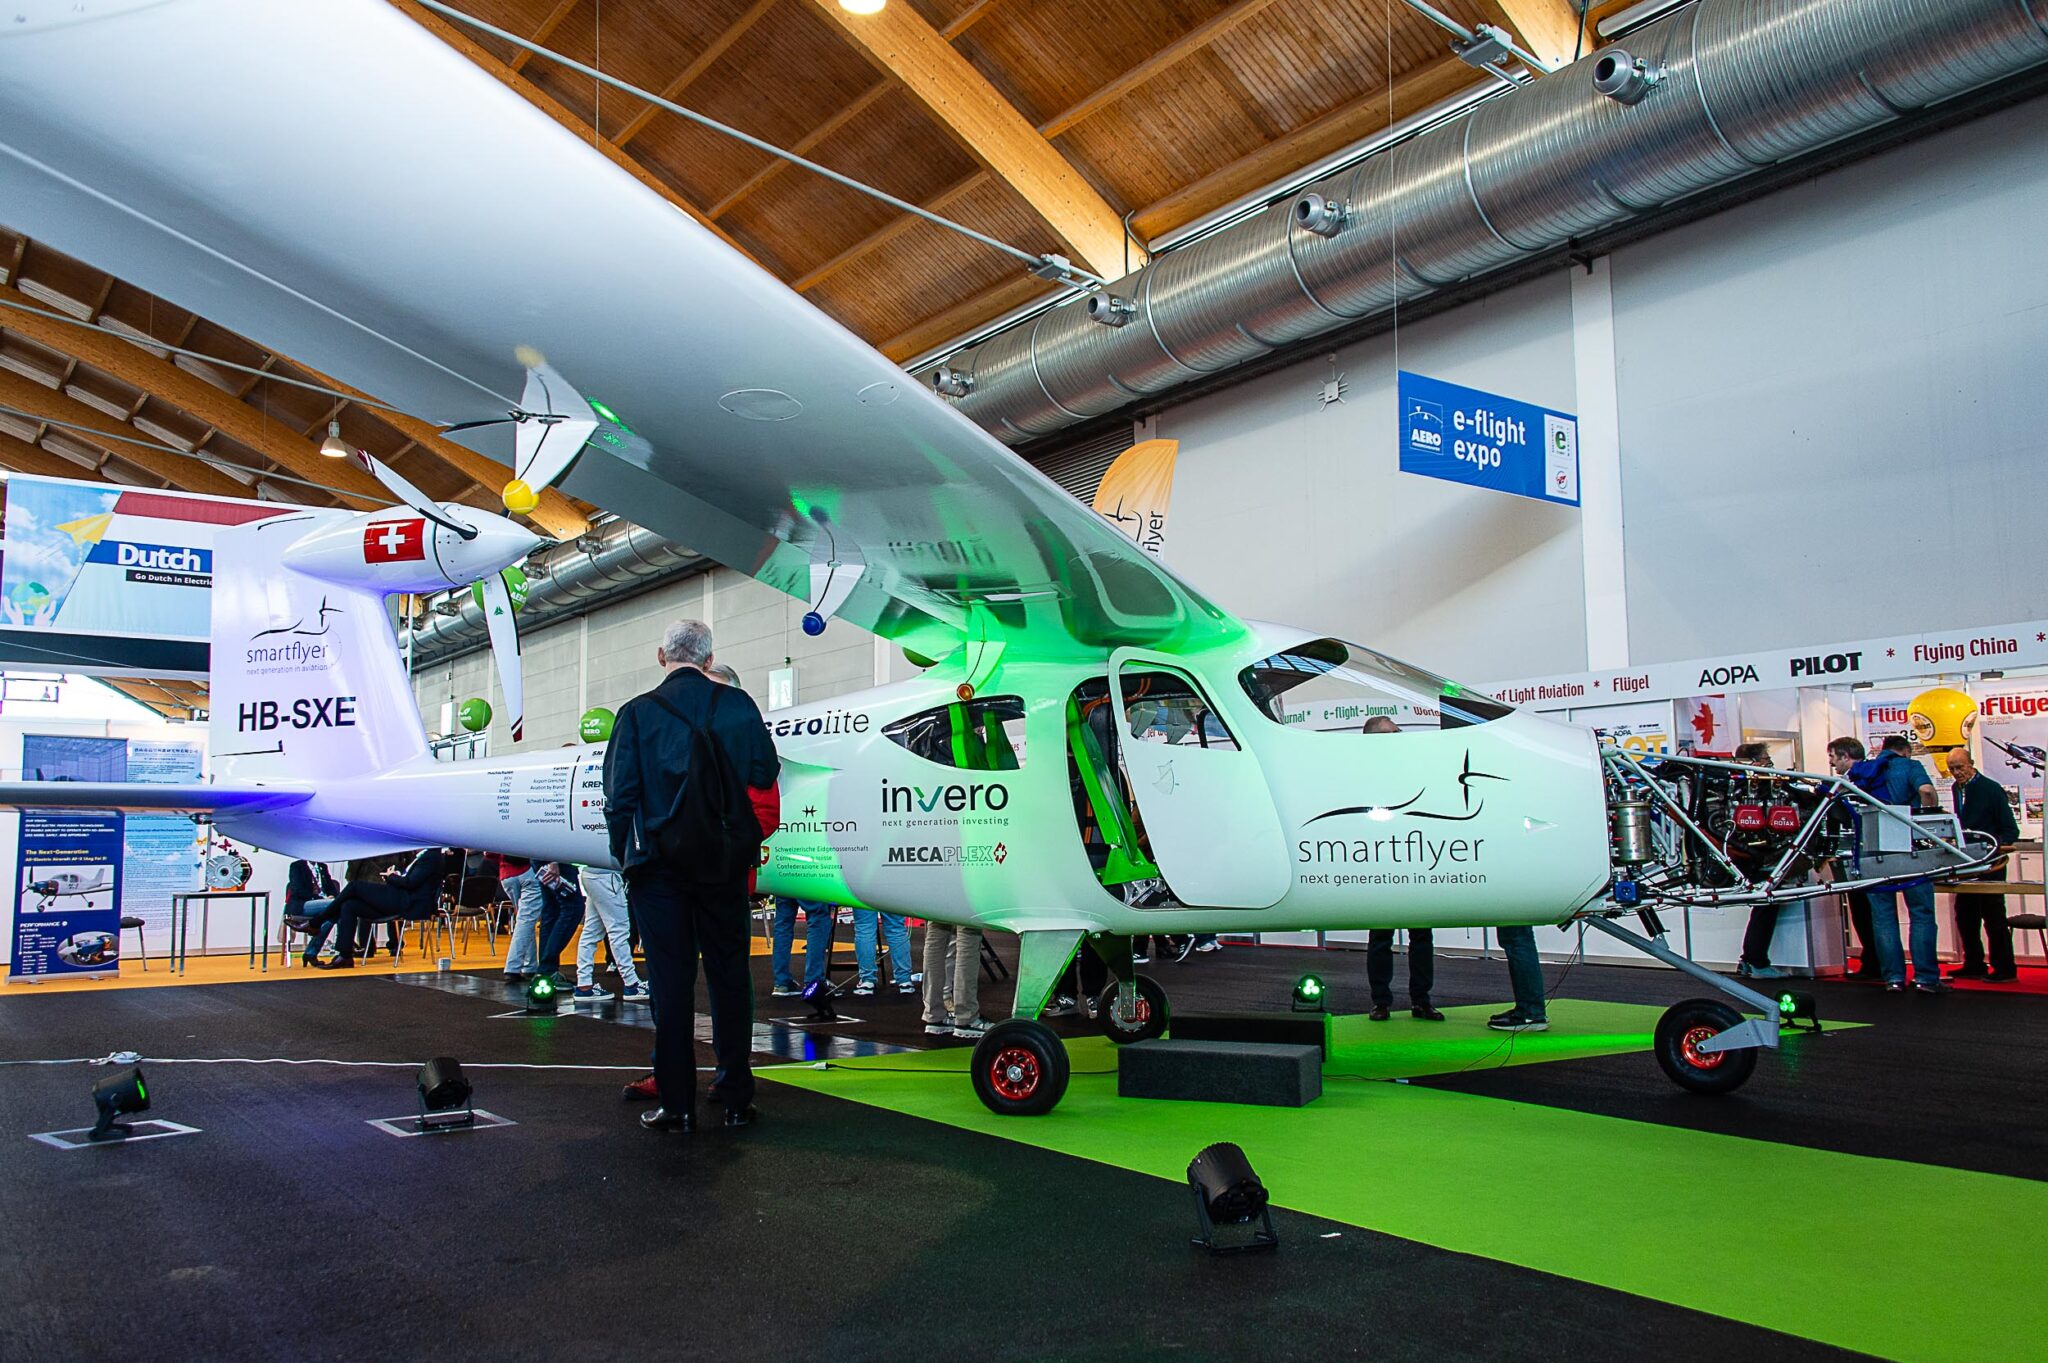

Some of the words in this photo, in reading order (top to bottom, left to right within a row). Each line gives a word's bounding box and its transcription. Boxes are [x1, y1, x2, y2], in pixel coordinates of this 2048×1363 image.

[1412, 428, 1442, 446] AERO
[1454, 409, 1526, 446] e-flight
[1454, 440, 1500, 470] expo
[118, 544, 201, 572] Dutch
[247, 641, 328, 664] smartflyer
[1914, 643, 1964, 663] Flying
[1970, 637, 2017, 656] China
[1698, 665, 1760, 687] AOPA
[1790, 652, 1862, 677] PILOT
[1509, 687, 1535, 704] Light
[1539, 683, 1584, 700] Aviation
[1613, 675, 1650, 693] Flügel
[238, 696, 356, 732] HB-SXE
[1324, 704, 1398, 720] e-flight-Journal
[882, 778, 1008, 813] invero
[906, 818, 959, 828] generation
[963, 816, 1009, 826] investing
[889, 846, 993, 862] MECAPLEX
[1298, 830, 1484, 871] smartflyer
[1300, 874, 1329, 883] next
[1334, 873, 1409, 887] generation
[1414, 873, 1426, 883] in
[1430, 873, 1486, 883] aviation
